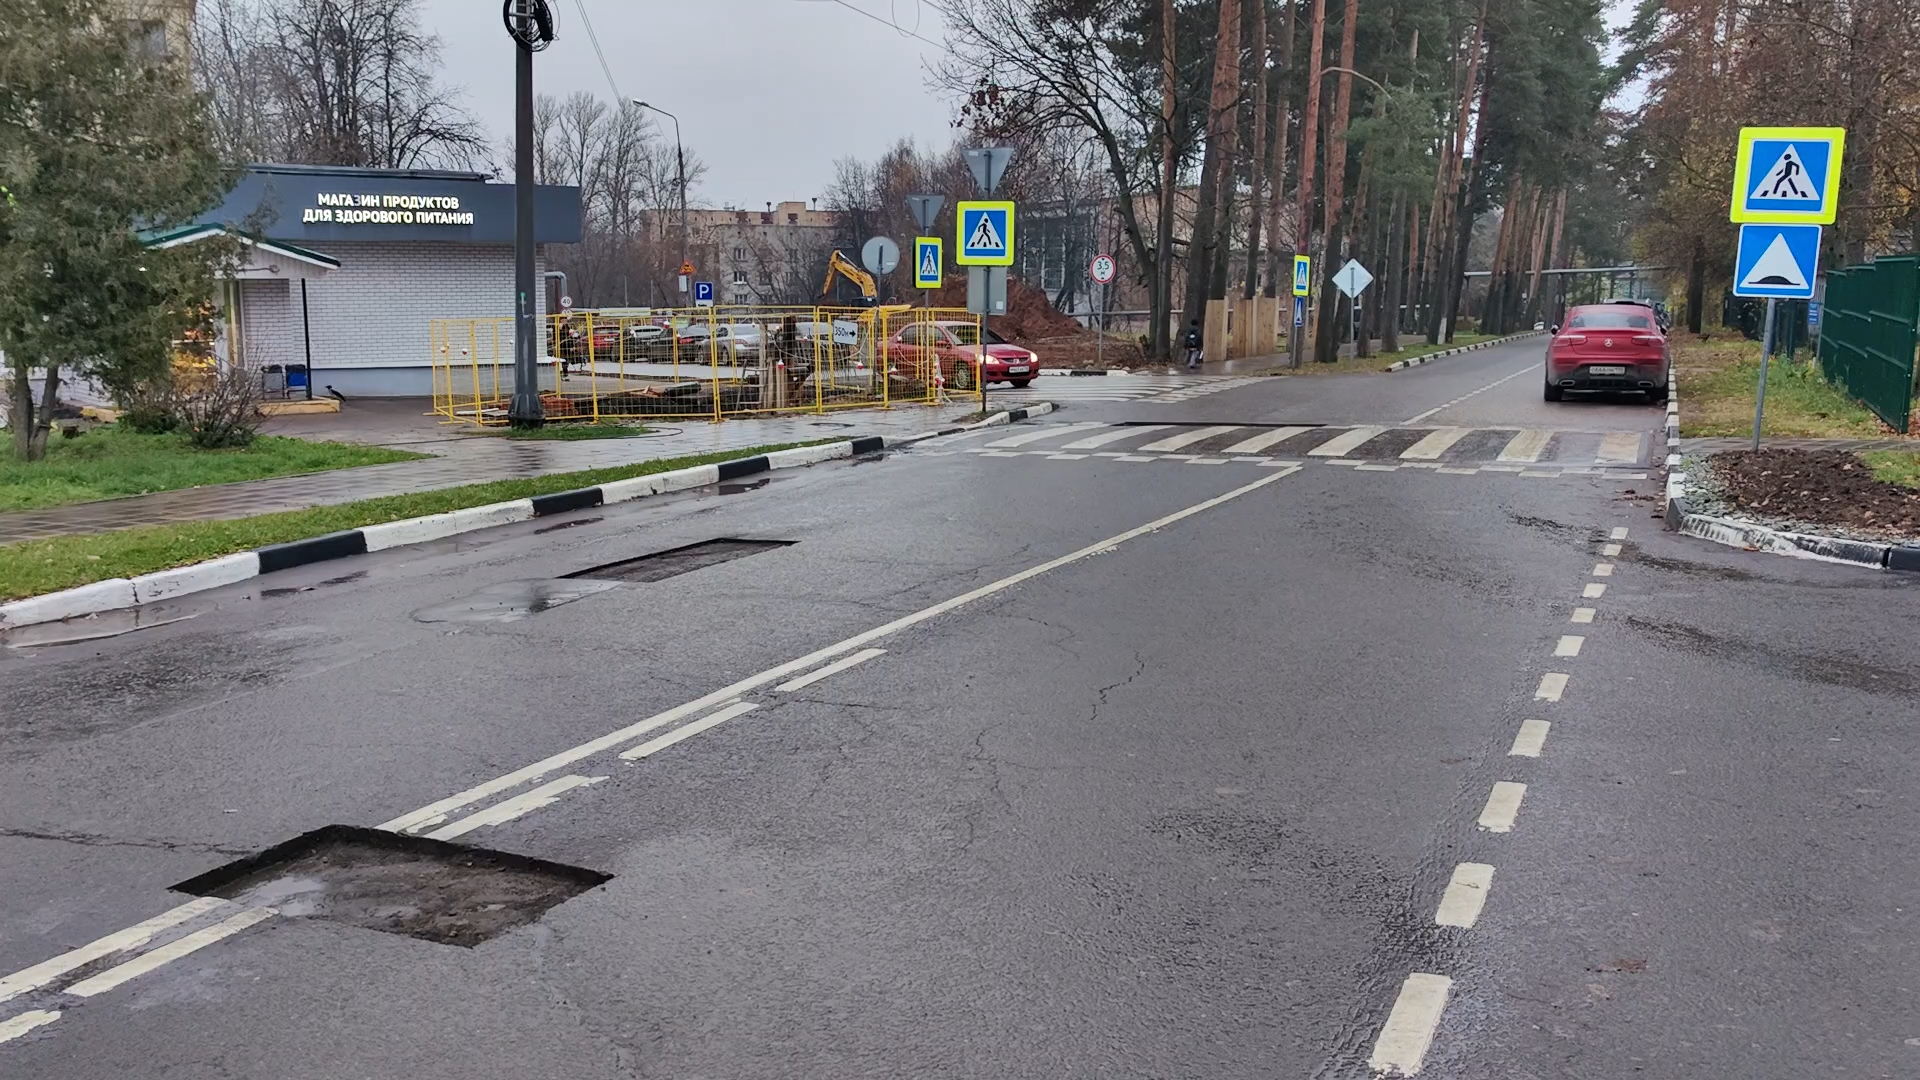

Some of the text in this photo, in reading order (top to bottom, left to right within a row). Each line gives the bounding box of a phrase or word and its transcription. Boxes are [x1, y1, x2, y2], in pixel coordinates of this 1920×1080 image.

[317, 193, 460, 210] МАГАЗИН ПРОДУКТОВ
[302, 208, 474, 225] ДЛЯ ЗДОРОВОГО ПИТАНИЯ
[699, 284, 710, 299] P
